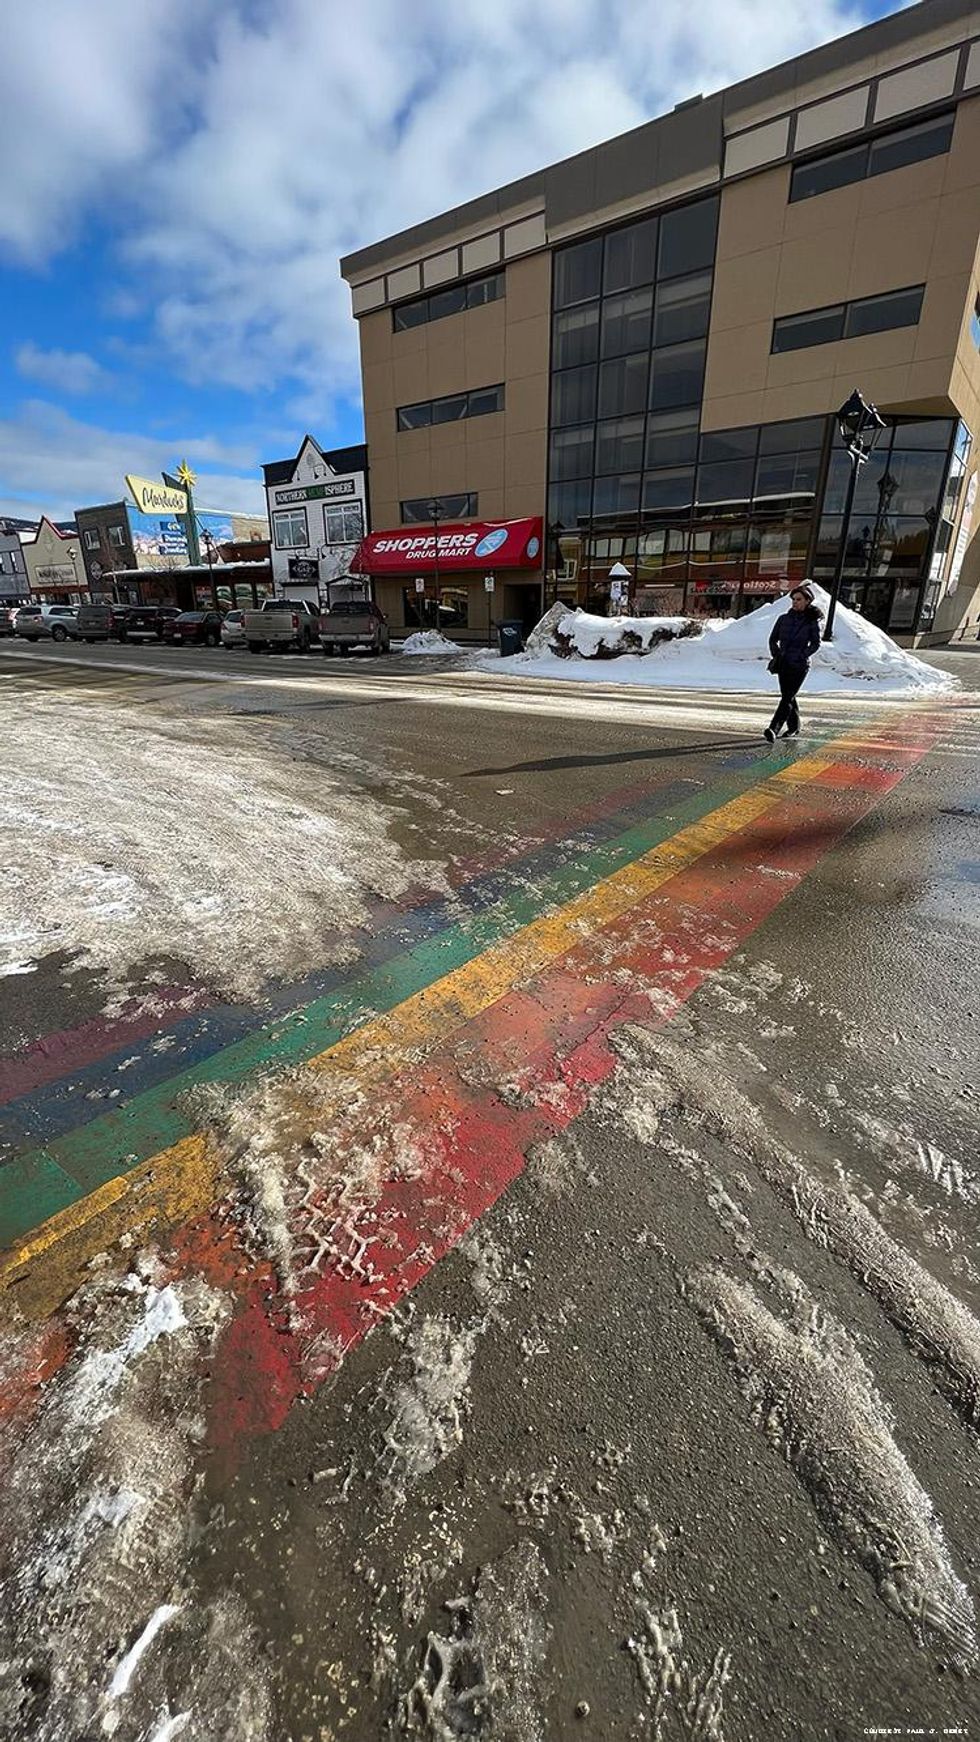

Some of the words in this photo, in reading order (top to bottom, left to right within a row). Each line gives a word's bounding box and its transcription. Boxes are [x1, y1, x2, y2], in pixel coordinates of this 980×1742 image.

[372, 532, 479, 555] SHOPPERS
[405, 549, 437, 560] DRUG
[438, 547, 472, 558] MART
